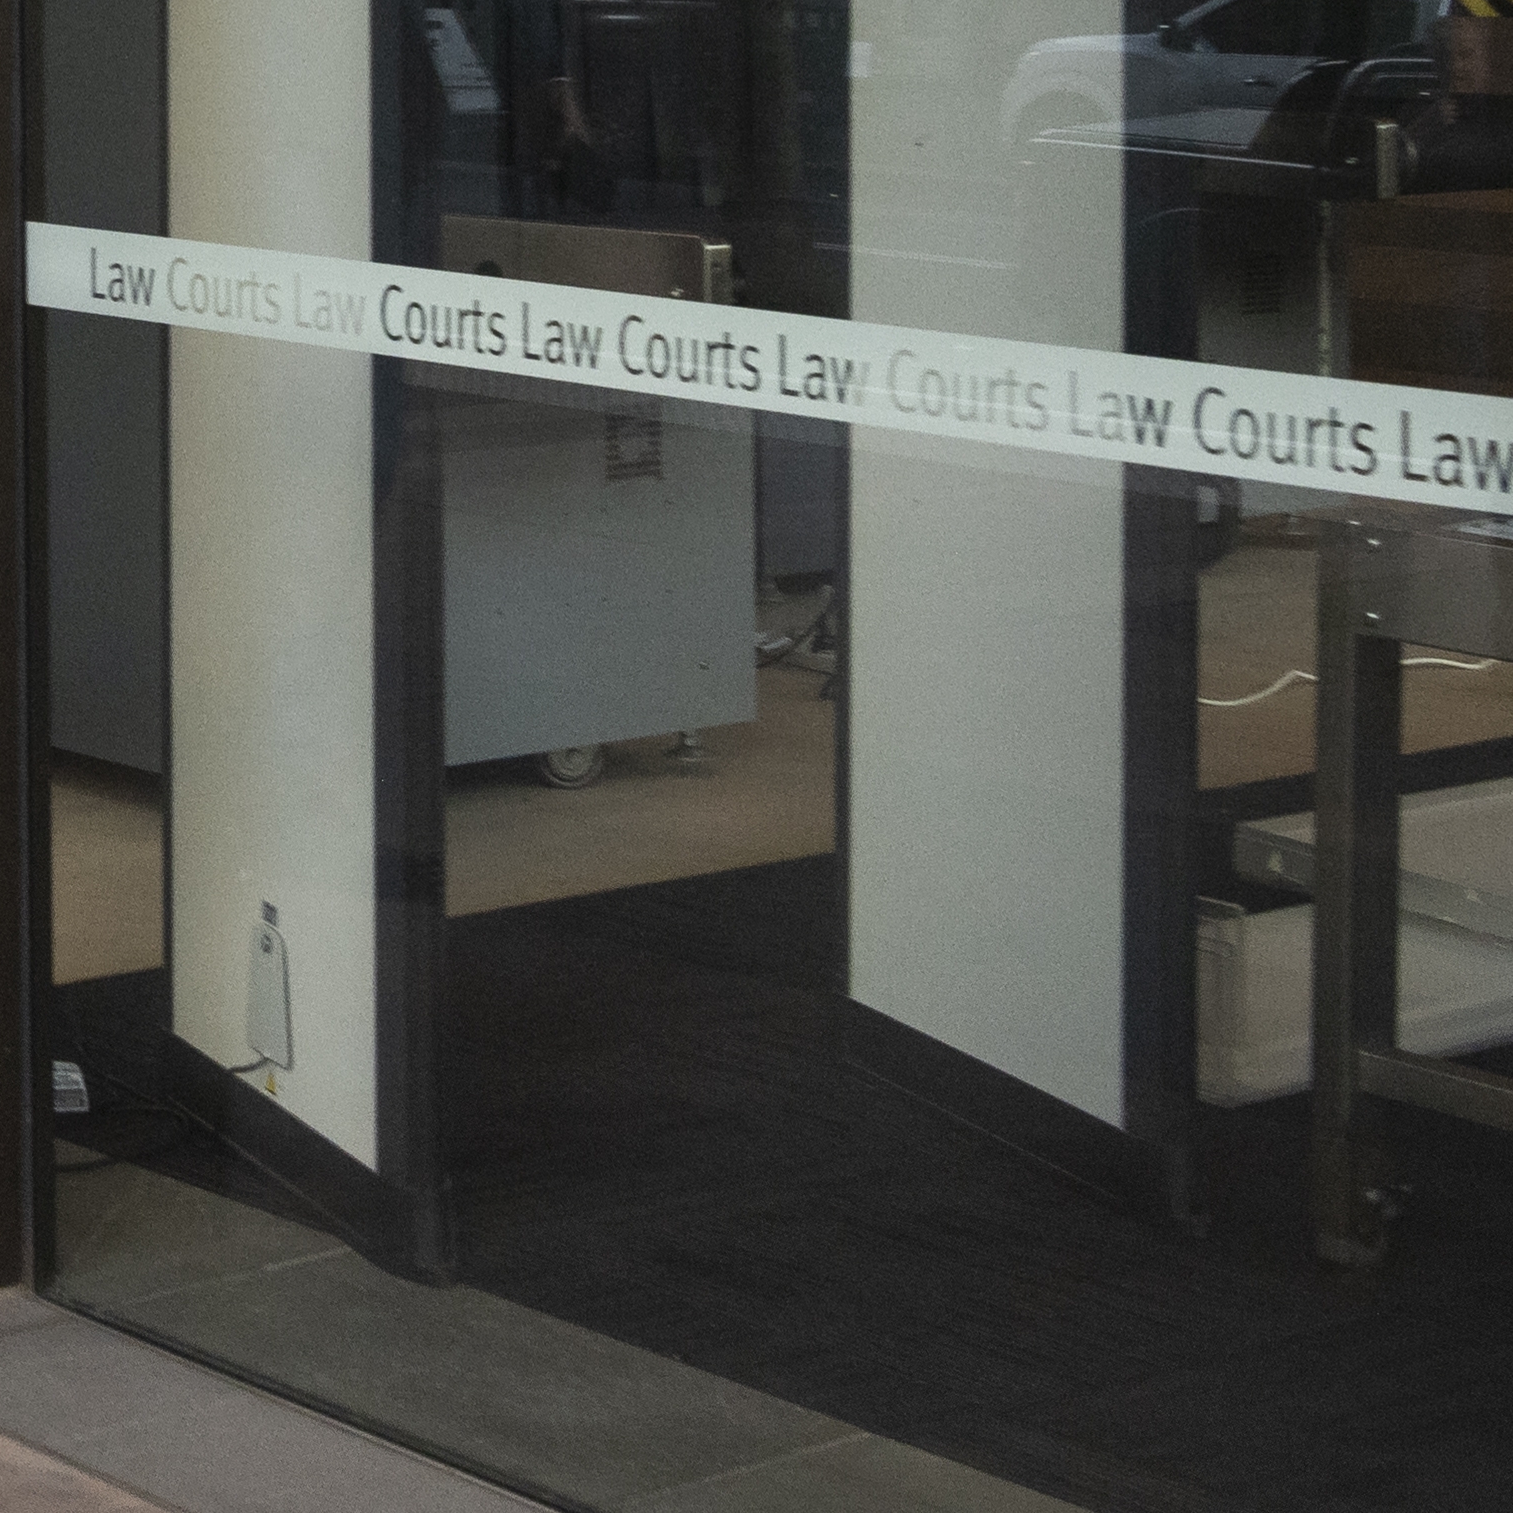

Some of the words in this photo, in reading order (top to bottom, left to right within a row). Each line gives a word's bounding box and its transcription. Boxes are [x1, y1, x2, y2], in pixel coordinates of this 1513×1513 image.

[90, 247, 156, 307] Law
[167, 257, 282, 324] Courts
[294, 272, 367, 336] Law
[379, 284, 507, 356] Courts
[522, 301, 603, 369] Law
[618, 315, 762, 392] Courts
[778, 333, 871, 406] Law
[887, 349, 1049, 431] Courts
[1068, 370, 1173, 448] Law
[1194, 387, 1379, 476] Courts
[1400, 410, 1513, 493] Law
